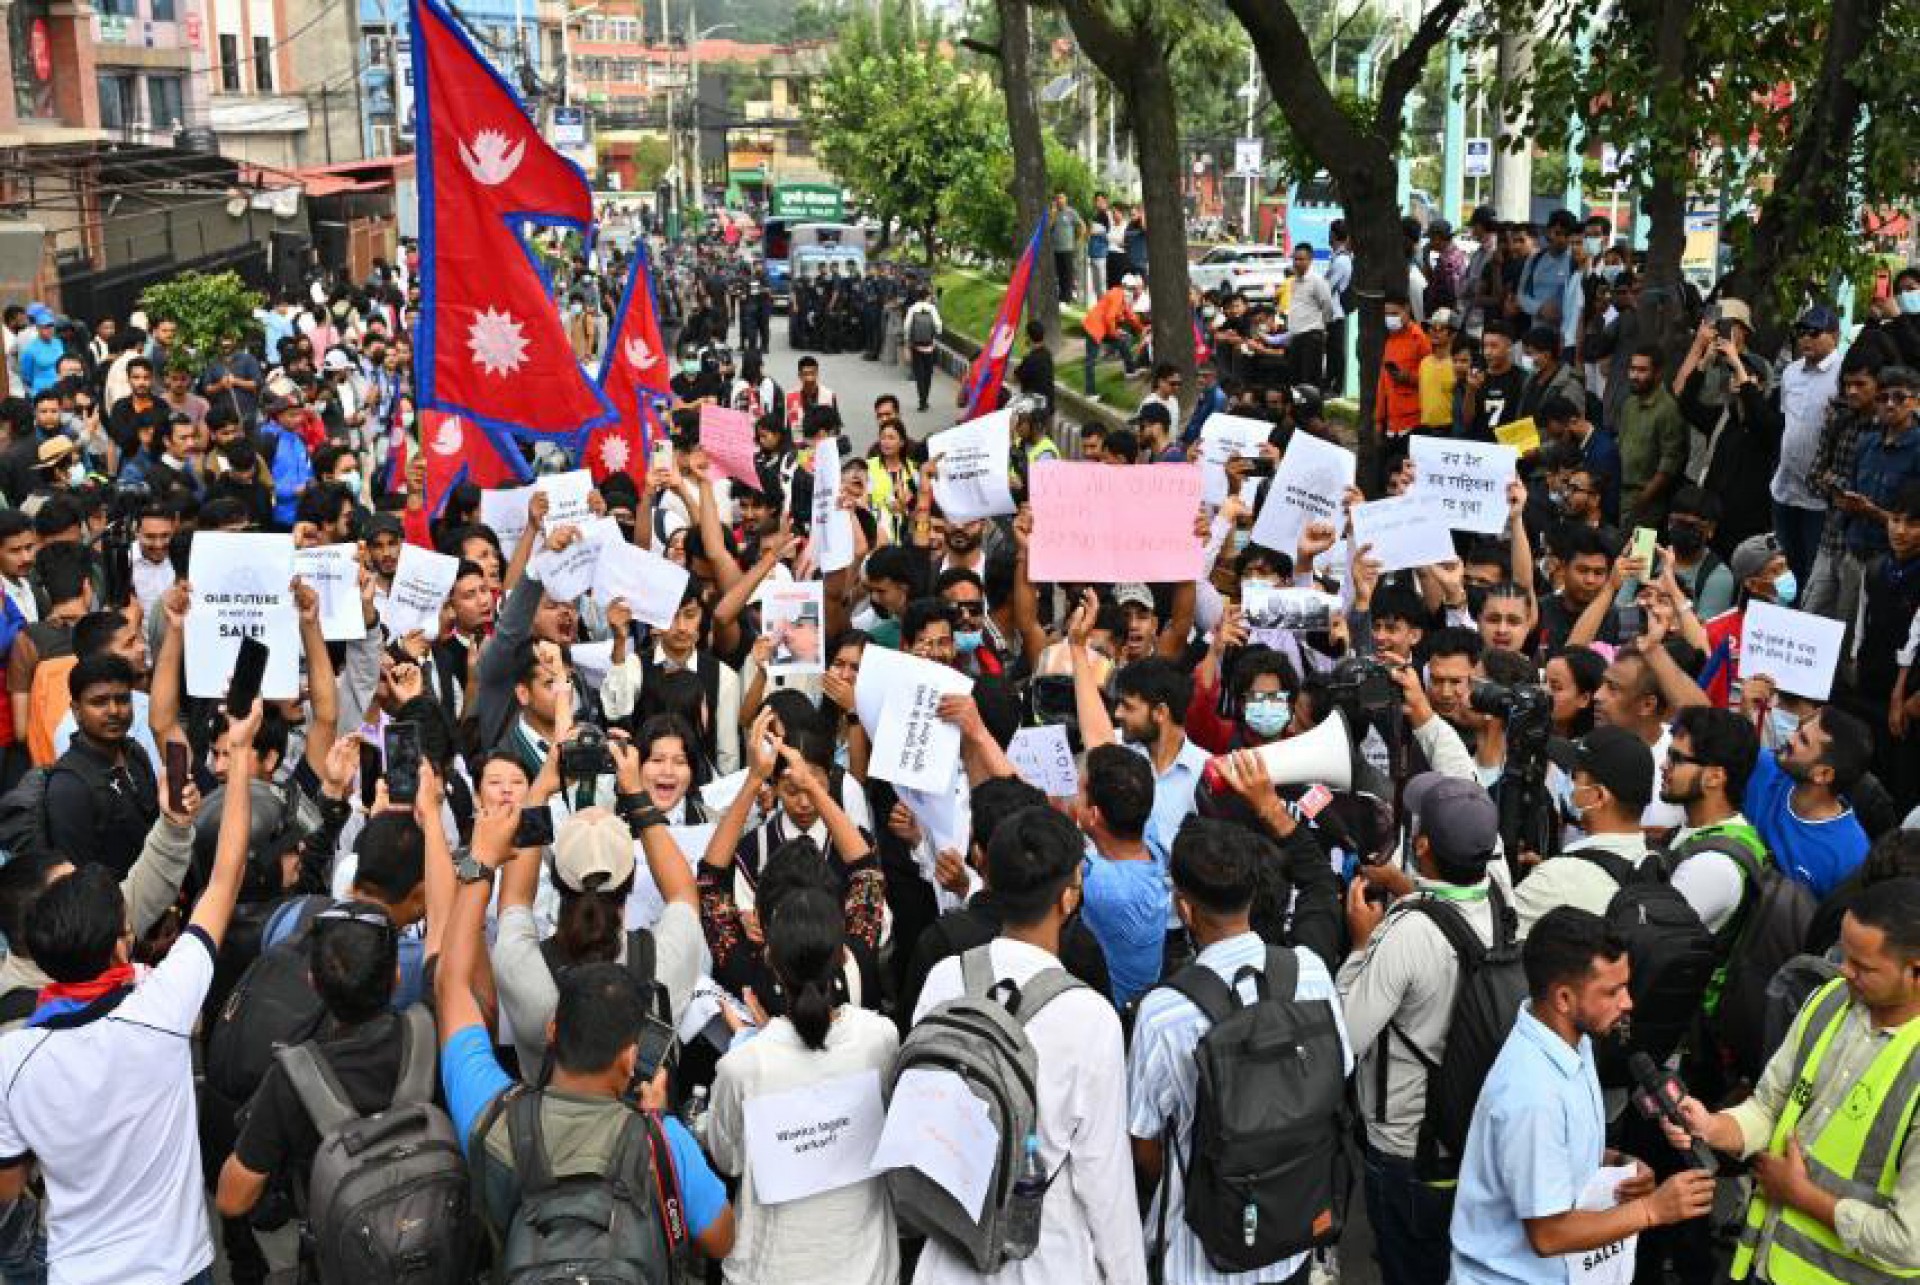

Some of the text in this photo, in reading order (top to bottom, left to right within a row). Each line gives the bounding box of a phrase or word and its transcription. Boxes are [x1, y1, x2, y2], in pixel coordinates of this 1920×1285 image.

[1485, 398, 1505, 428] 7
[204, 593, 280, 605] OUR FUTURE
[219, 623, 265, 637] SALE!
[1583, 1238, 1624, 1271] SALE!
